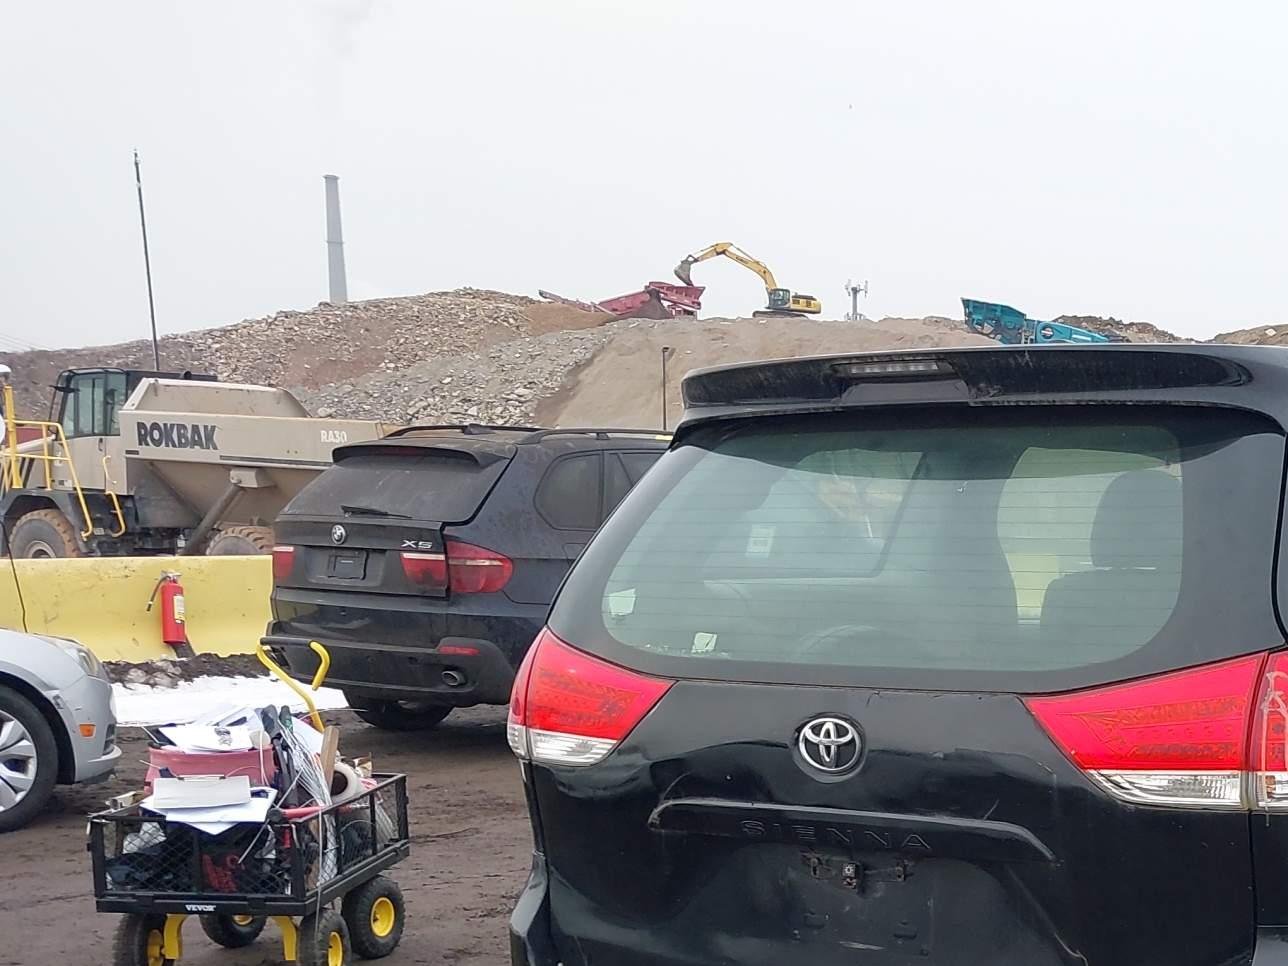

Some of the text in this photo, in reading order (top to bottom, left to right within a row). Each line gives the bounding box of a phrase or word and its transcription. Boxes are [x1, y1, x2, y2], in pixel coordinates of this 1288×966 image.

[137, 421, 219, 450] ROKBAK
[320, 430, 348, 443] RA30
[401, 539, 433, 549] X5
[740, 819, 932, 850] SIENNA
